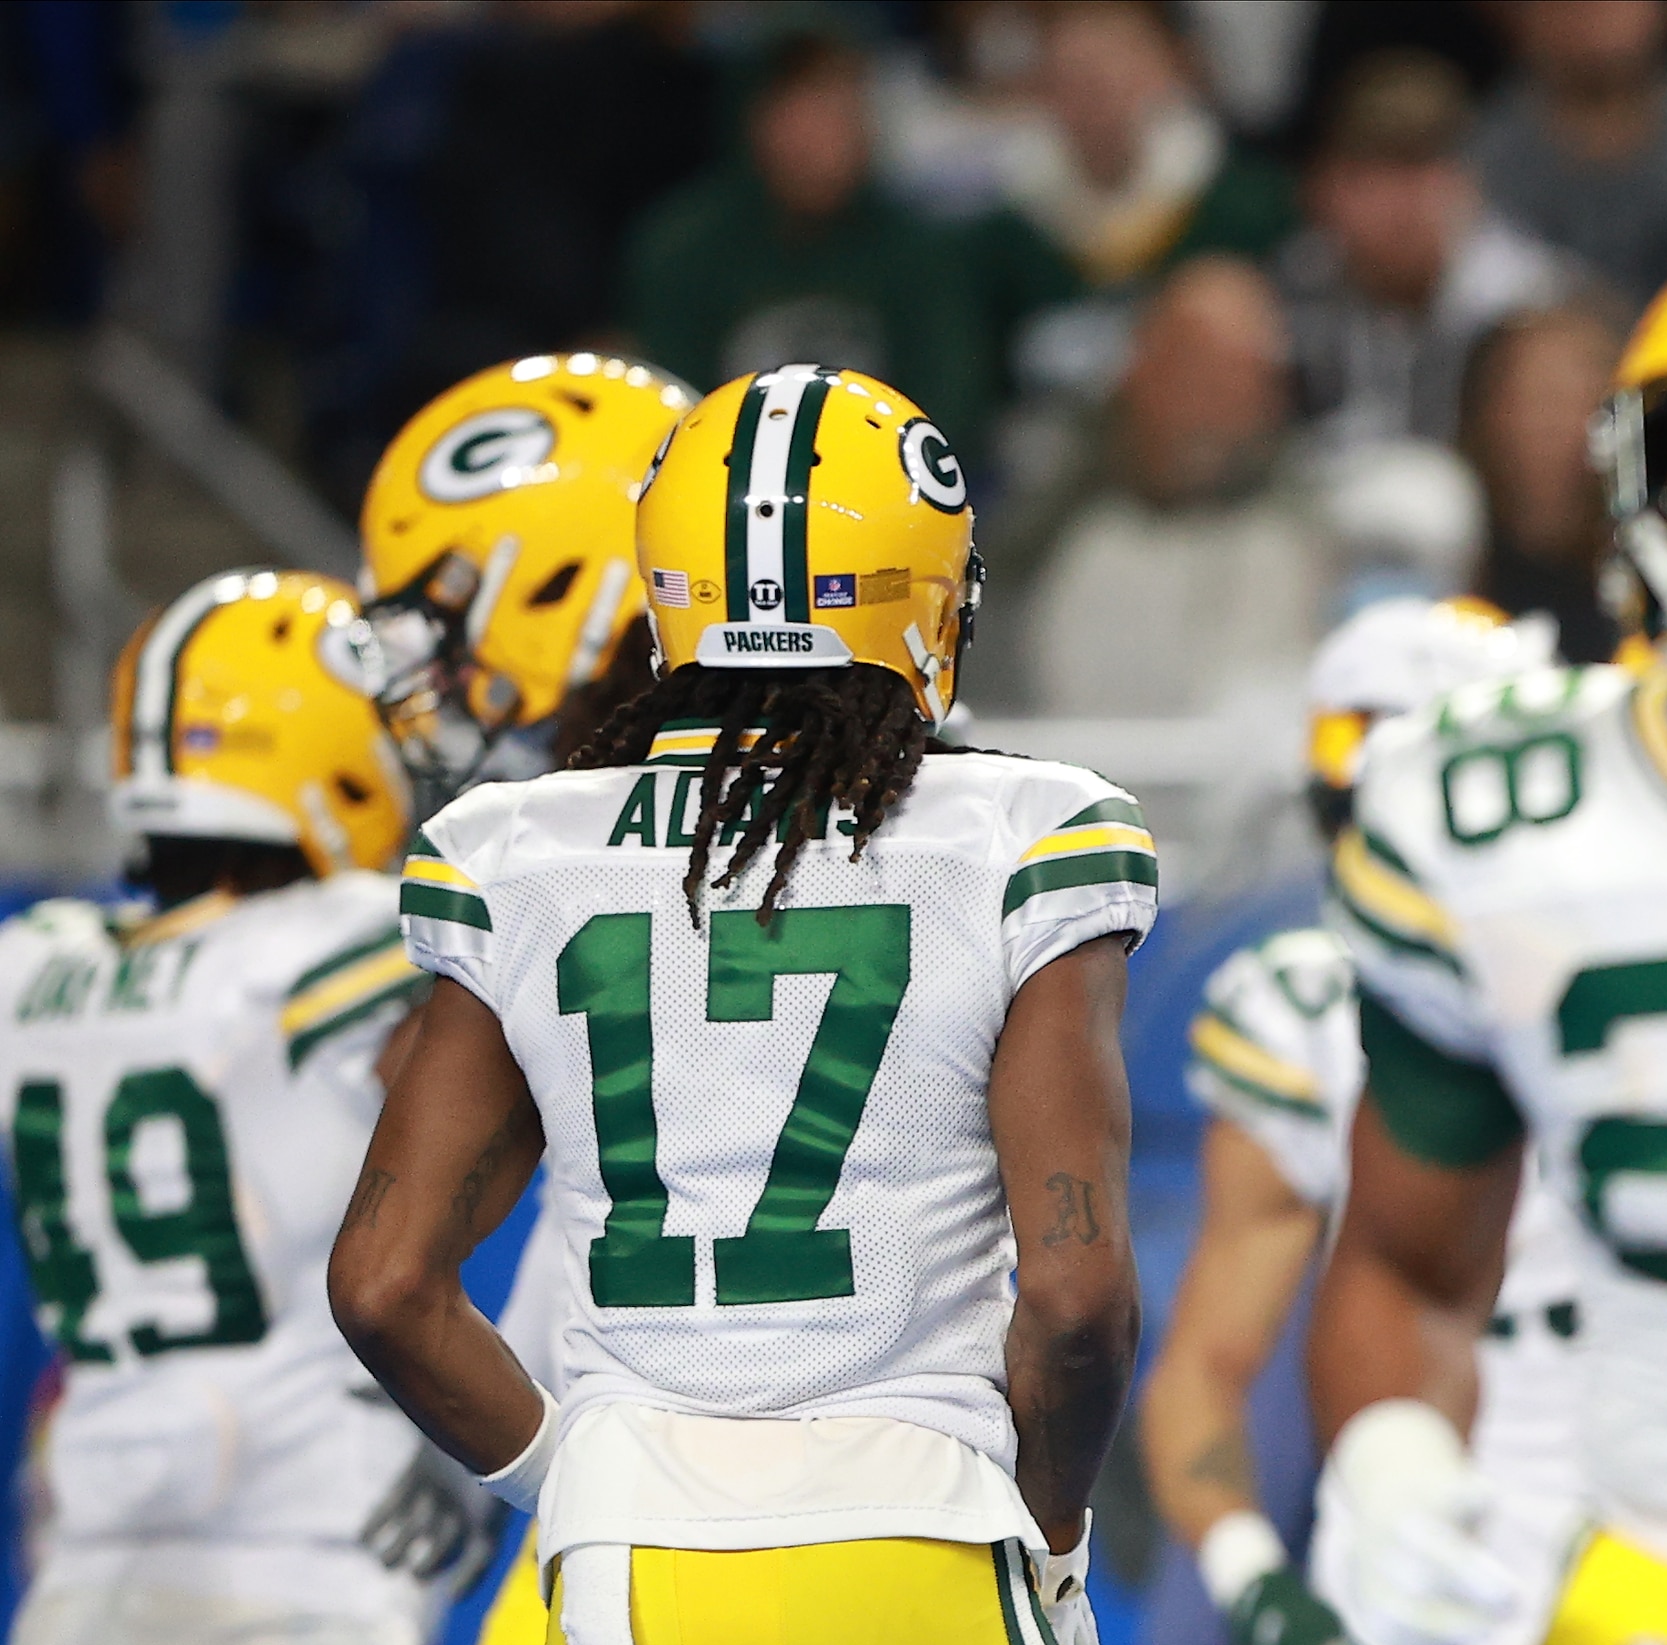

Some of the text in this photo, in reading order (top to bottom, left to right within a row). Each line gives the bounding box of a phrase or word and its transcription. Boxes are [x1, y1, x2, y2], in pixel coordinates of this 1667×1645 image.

[418, 406, 558, 505] G
[899, 417, 969, 513] G
[723, 630, 814, 653] PACKERS
[607, 770, 860, 847] ADA
[556, 903, 911, 1308] 17
[11, 1064, 271, 1364] 49
